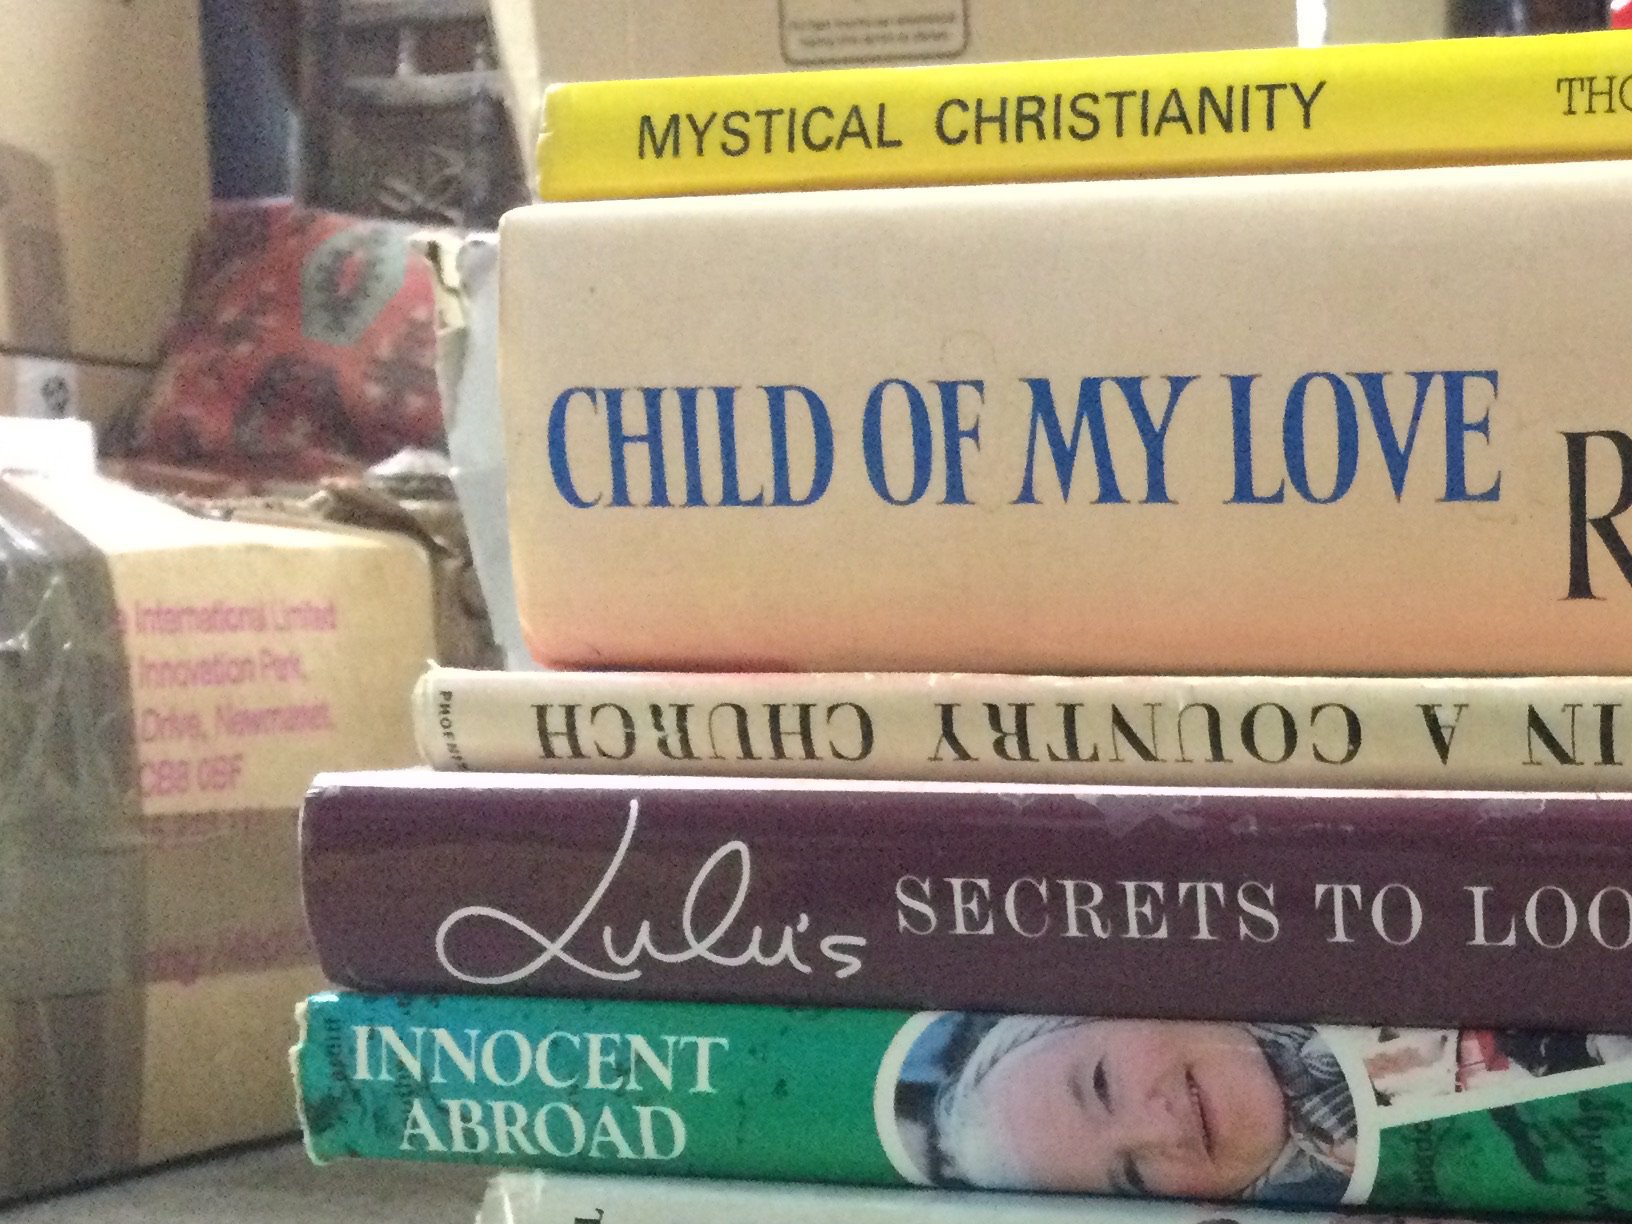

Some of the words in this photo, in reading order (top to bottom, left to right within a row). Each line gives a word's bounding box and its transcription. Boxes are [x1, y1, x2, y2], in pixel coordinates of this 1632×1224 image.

[638, 103, 903, 160] MYSTICAL
[935, 80, 1327, 146] CHRISTIANITY
[548, 383, 834, 509] CHILD
[862, 378, 984, 506] OF
[1011, 374, 1202, 507] MY
[1219, 370, 1502, 506] LOVE
[531, 701, 876, 764] CHURCH
[928, 700, 1363, 765] COUNTRY
[1416, 702, 1465, 766] A
[1524, 702, 1623, 766] IN
[435, 798, 867, 984] Lulu's
[894, 875, 1280, 944] SECRETS
[1314, 881, 1423, 948] TO
[350, 1025, 729, 1095] INNOCENT
[400, 1098, 687, 1161] ABROAD
